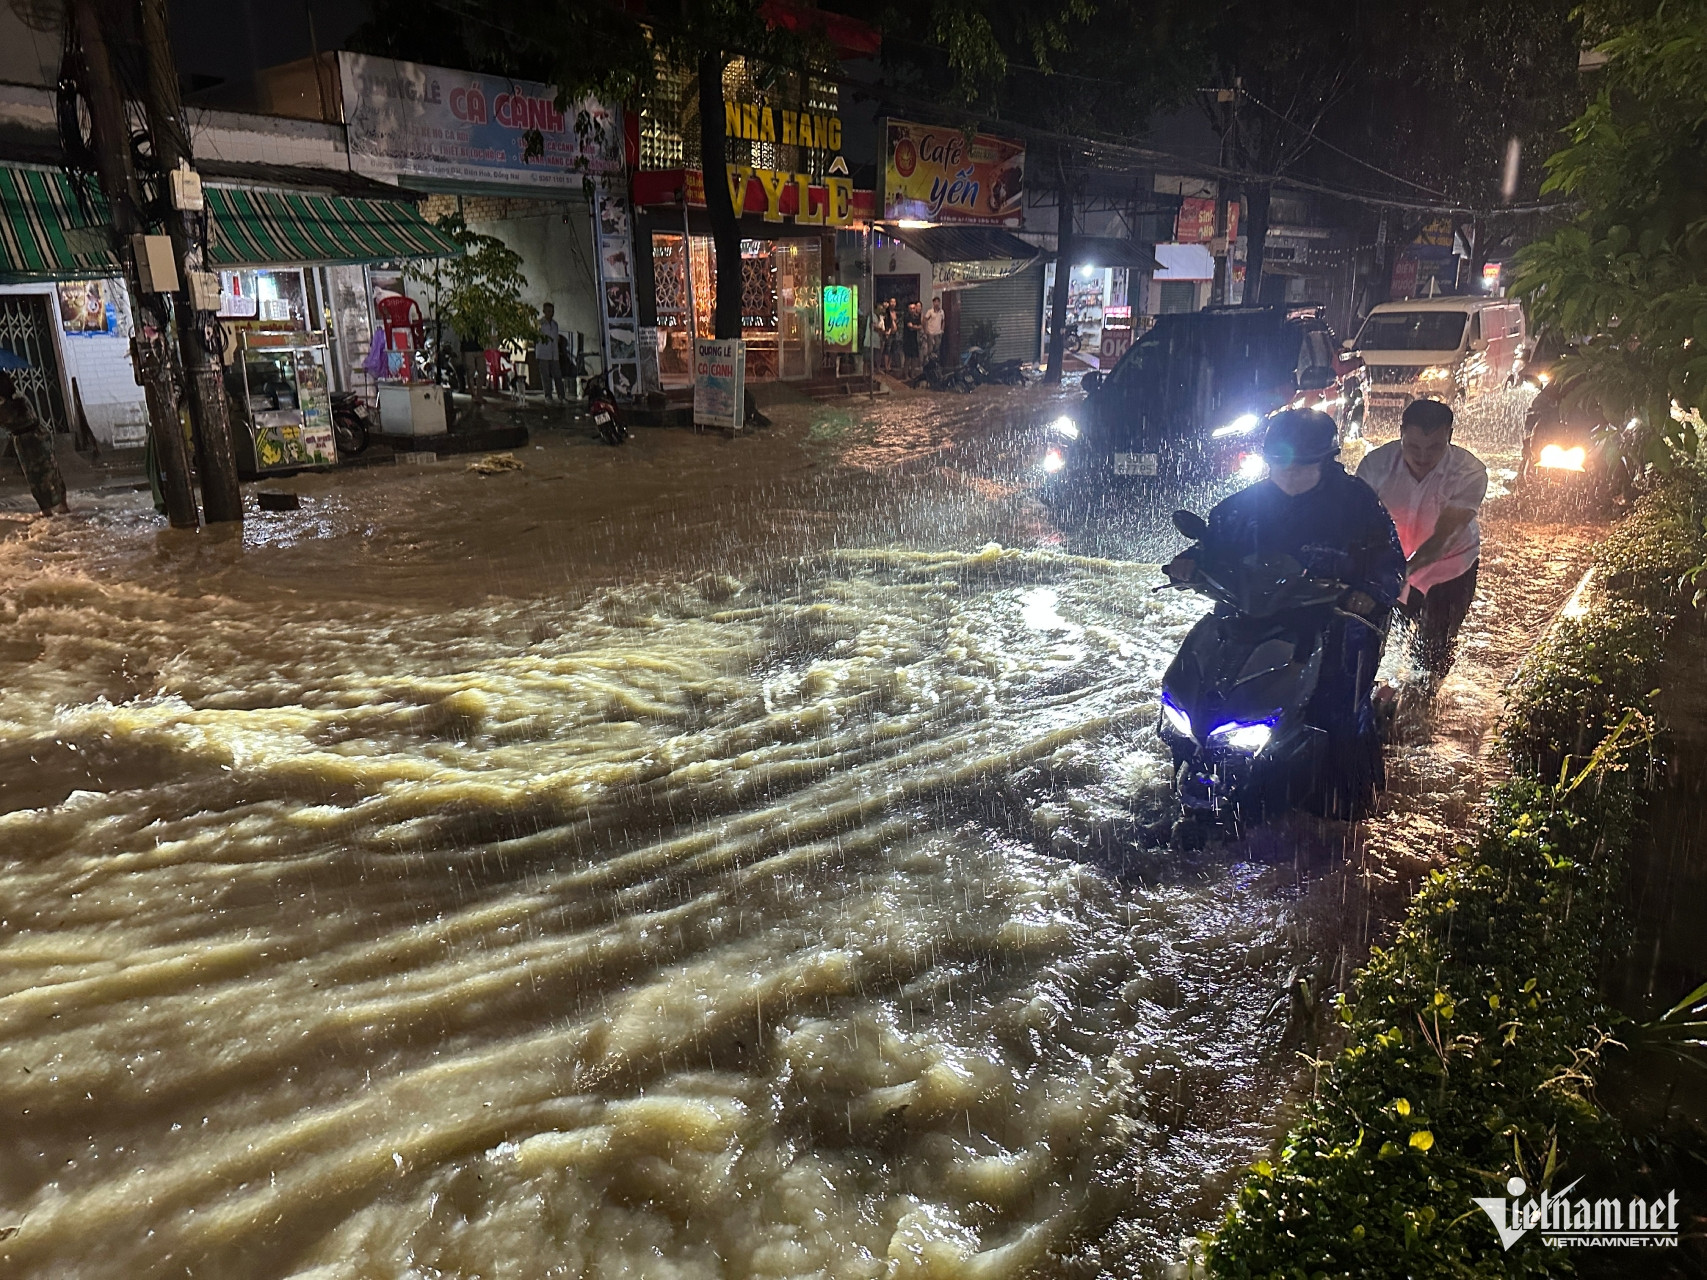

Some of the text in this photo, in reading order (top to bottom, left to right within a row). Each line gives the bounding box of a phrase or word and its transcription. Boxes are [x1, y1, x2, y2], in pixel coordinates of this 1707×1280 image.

[449, 81, 566, 134] CÁ CẢNH
[725, 96, 776, 142] NHÀ
[919, 134, 964, 174] Café
[926, 164, 980, 217] yến
[824, 288, 851, 306] Café
[827, 309, 850, 333] yến
[699, 345, 722, 357] QUANG
